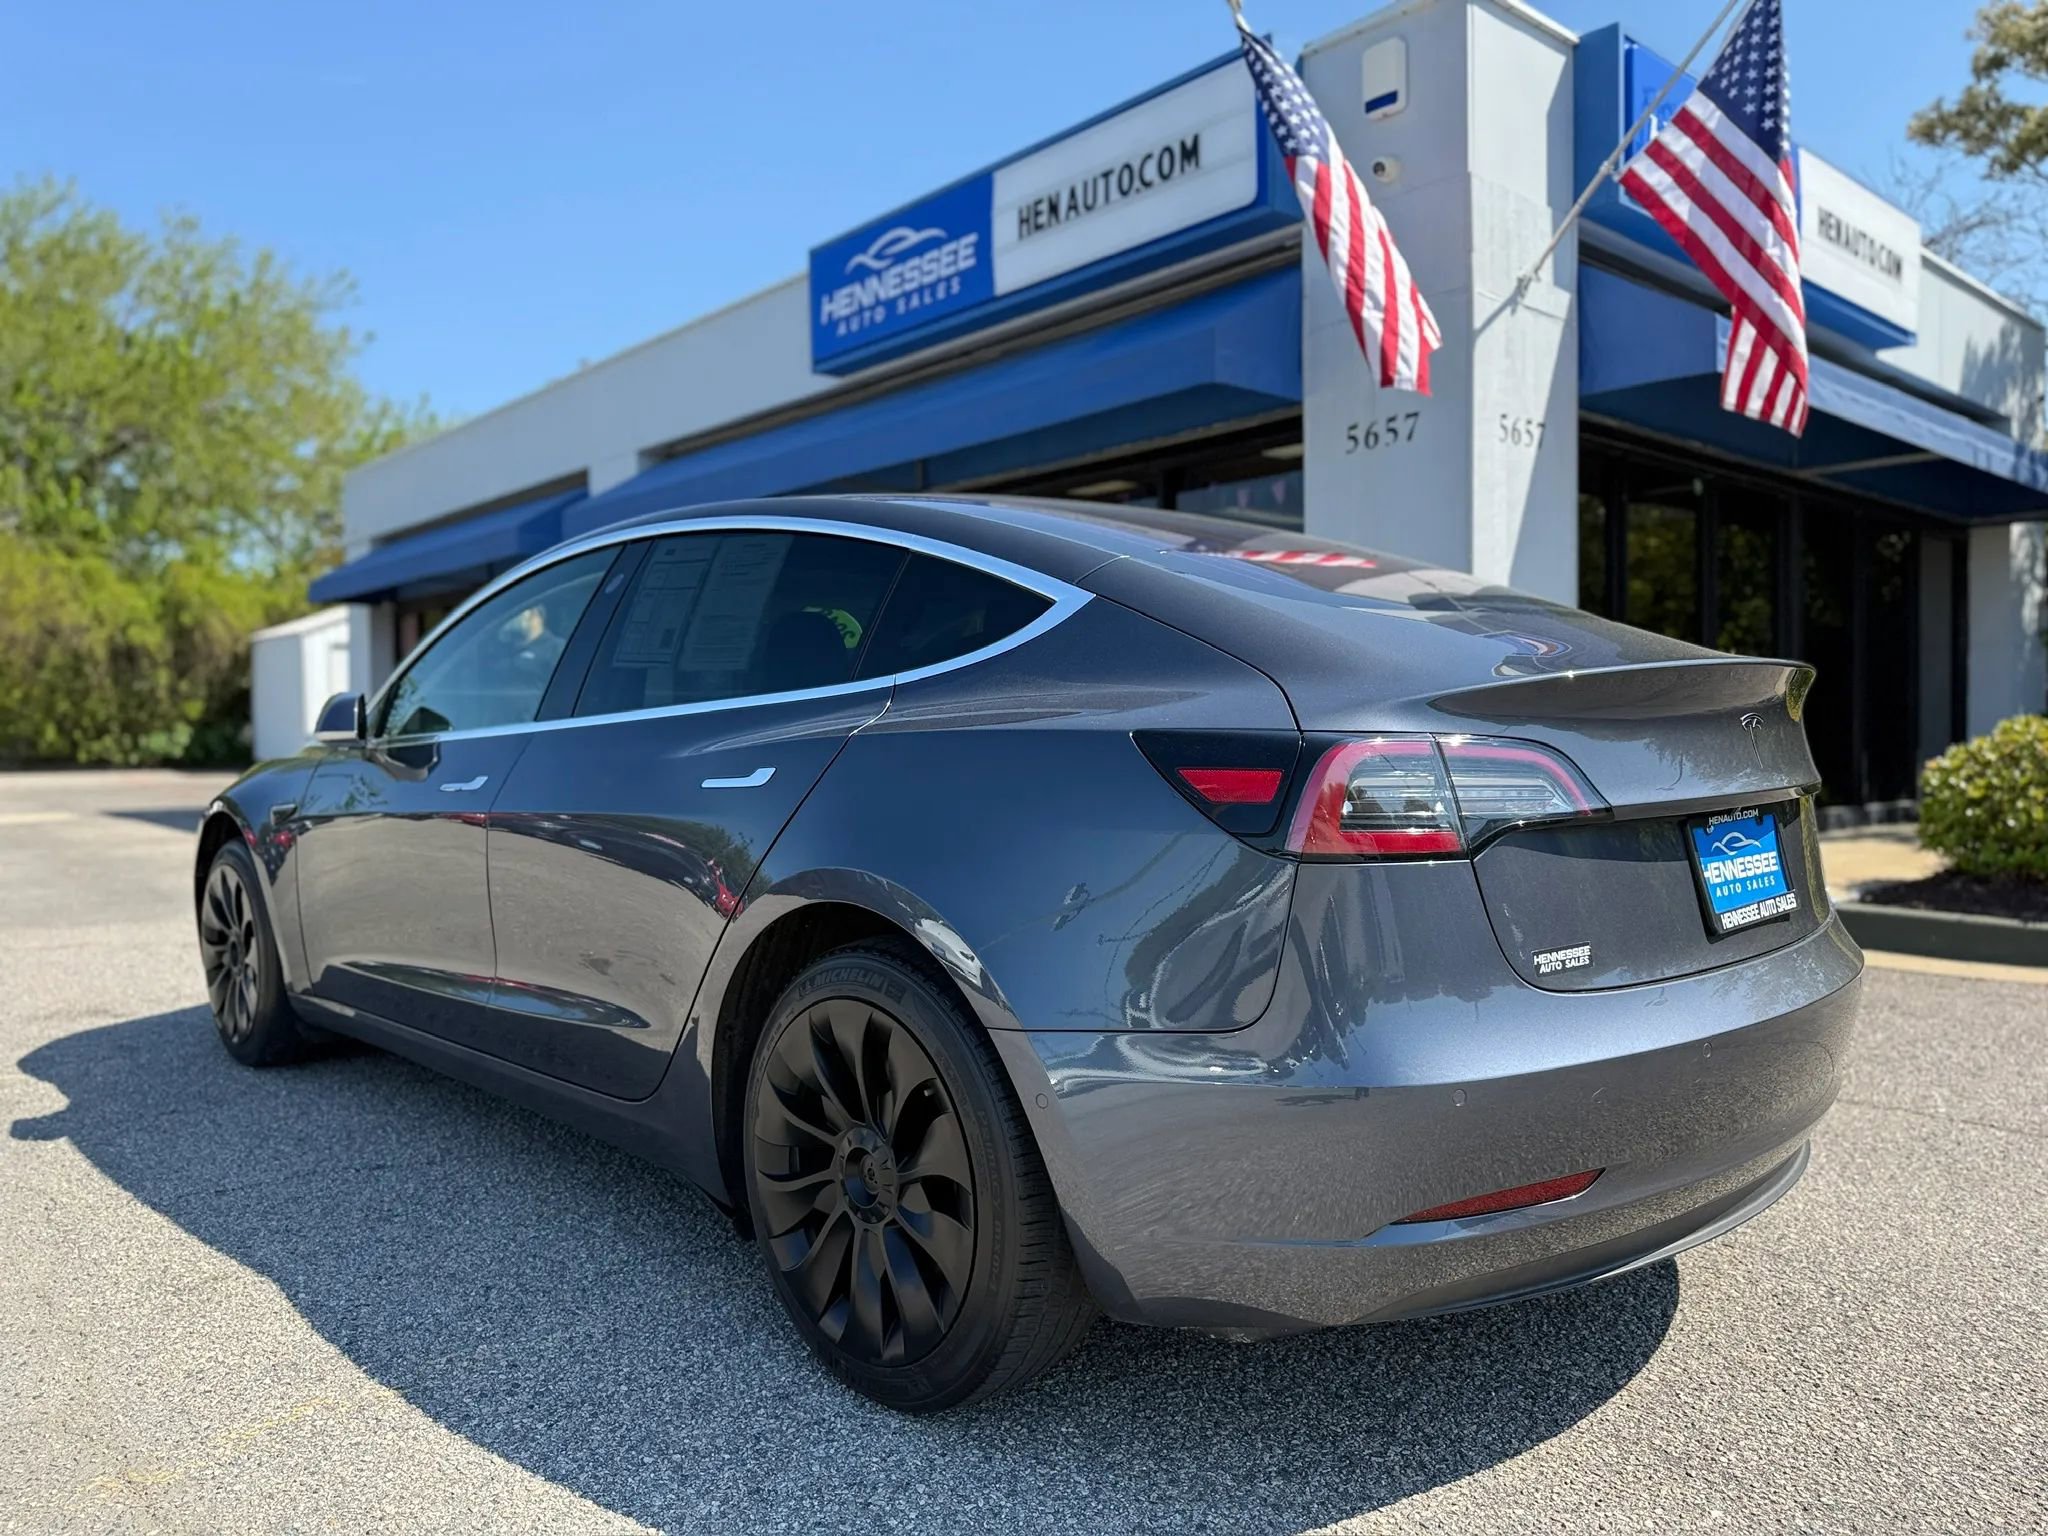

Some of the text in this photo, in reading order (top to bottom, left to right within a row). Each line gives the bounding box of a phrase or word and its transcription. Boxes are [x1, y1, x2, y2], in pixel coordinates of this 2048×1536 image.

[1018, 133, 1200, 241] HENAUTO.COM
[820, 231, 979, 326] HENNESSEE
[836, 275, 961, 337] AUTO SALES
[1346, 410, 1421, 455] 5657
[1498, 413, 1546, 450] 5657
[1708, 807, 1759, 826] HENAUTO.COM
[1702, 851, 1778, 885] HENNESSEE
[1716, 875, 1776, 898] AUTO SALES
[1720, 892, 1797, 930] HENNESSEE AUTO SALES
[1533, 945, 1591, 965] HENNESSEE
[1539, 955, 1590, 974] AUTO SALES
[814, 967, 885, 990] MICHELIN
